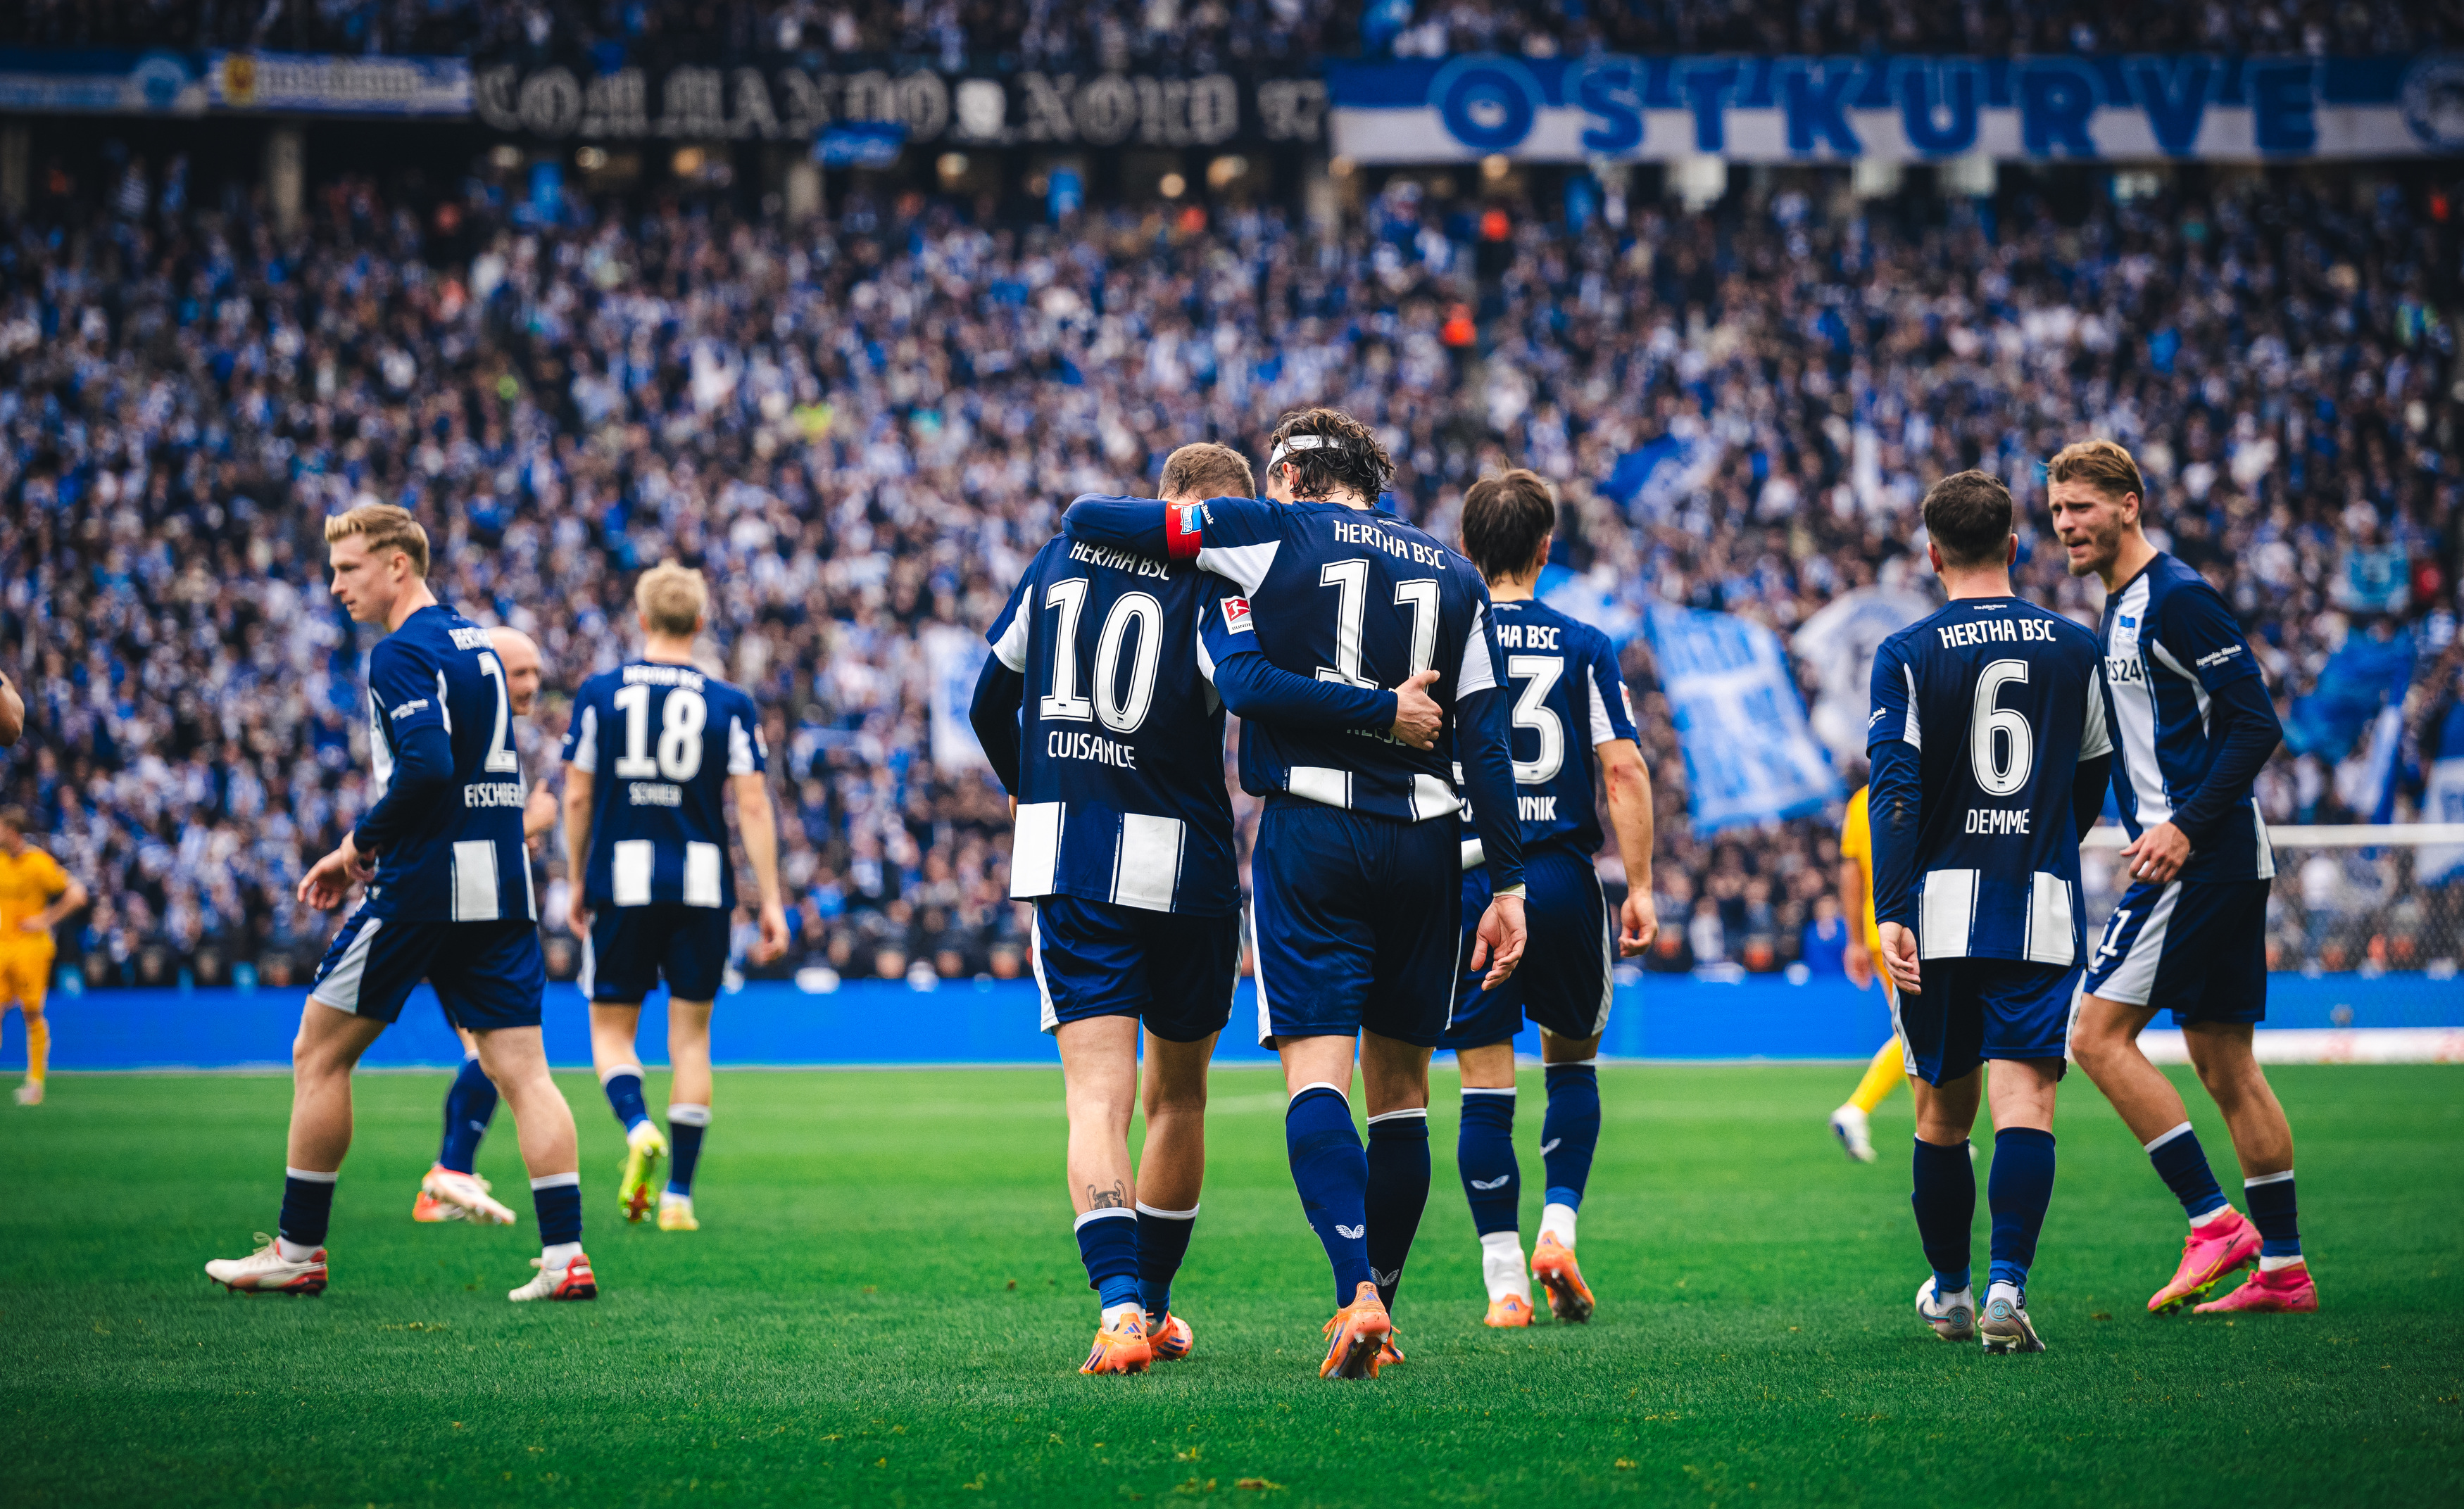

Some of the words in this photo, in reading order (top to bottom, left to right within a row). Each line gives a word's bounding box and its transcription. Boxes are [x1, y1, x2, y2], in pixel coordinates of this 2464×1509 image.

[1433, 56, 2320, 158] OSTKURVE
[1333, 520, 1409, 560] HERTHA
[1410, 542, 1446, 569] BSC
[1039, 577, 1164, 733] 10
[1231, 622, 1253, 631] BUNDE
[1315, 558, 1440, 695] 11
[1526, 625, 1561, 650] BSC
[1937, 619, 2018, 649] HERTHA
[2018, 618, 2056, 642] BSC
[477, 652, 519, 773] 2
[614, 682, 708, 783] 18
[1048, 731, 1137, 771] CUISANCE
[1508, 655, 1565, 785] 3
[1971, 659, 2033, 796] 6
[1965, 808, 2030, 835] DEMME
